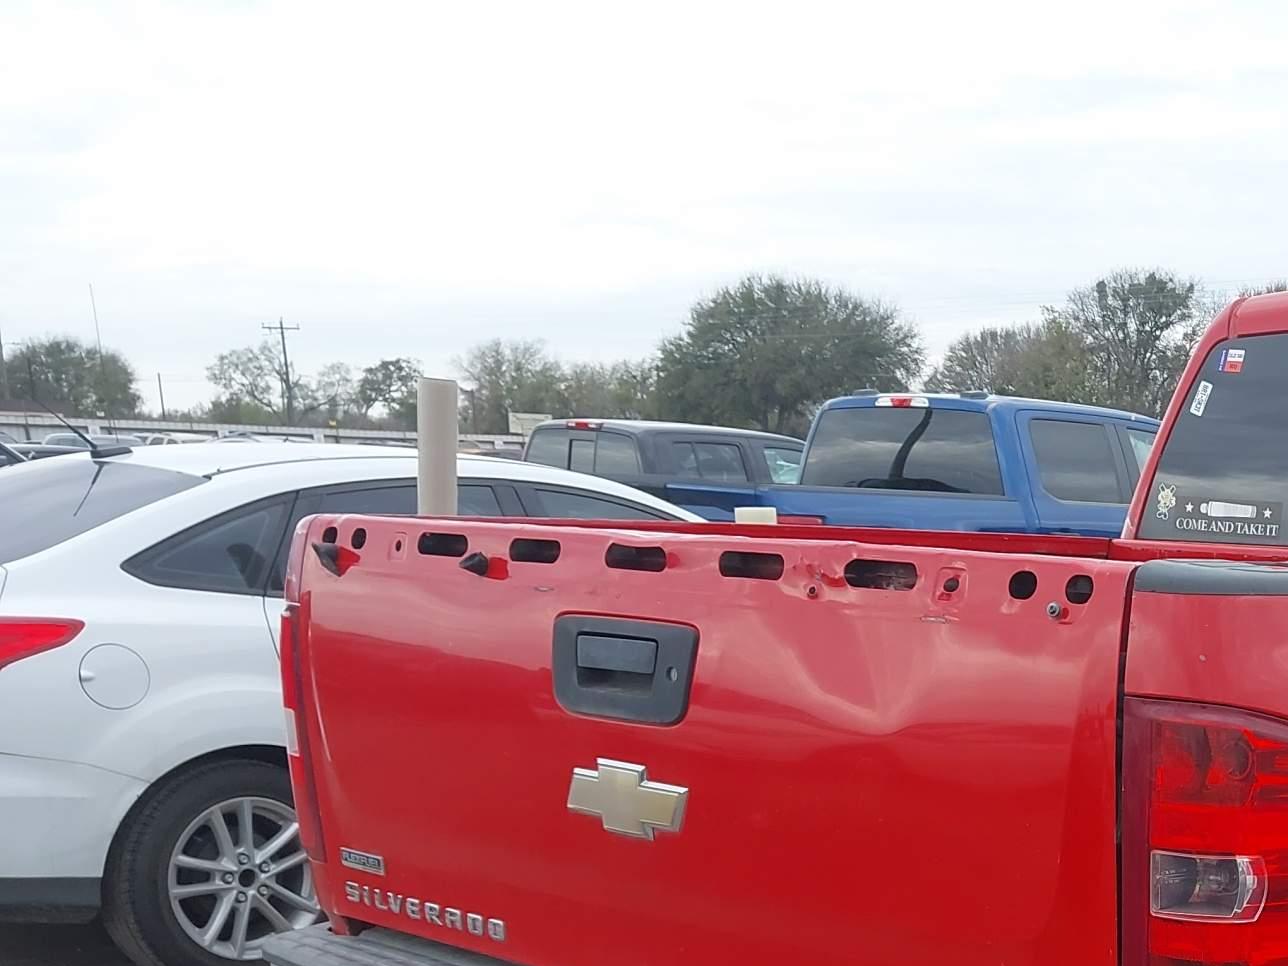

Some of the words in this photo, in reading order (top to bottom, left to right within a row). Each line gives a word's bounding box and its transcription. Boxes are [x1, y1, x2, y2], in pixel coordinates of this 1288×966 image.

[1175, 517, 1208, 531] COME
[1208, 520, 1234, 533] AND
[1235, 522, 1264, 536] TAKE
[1266, 524, 1279, 536] IT
[345, 881, 506, 941] SILVERADO
